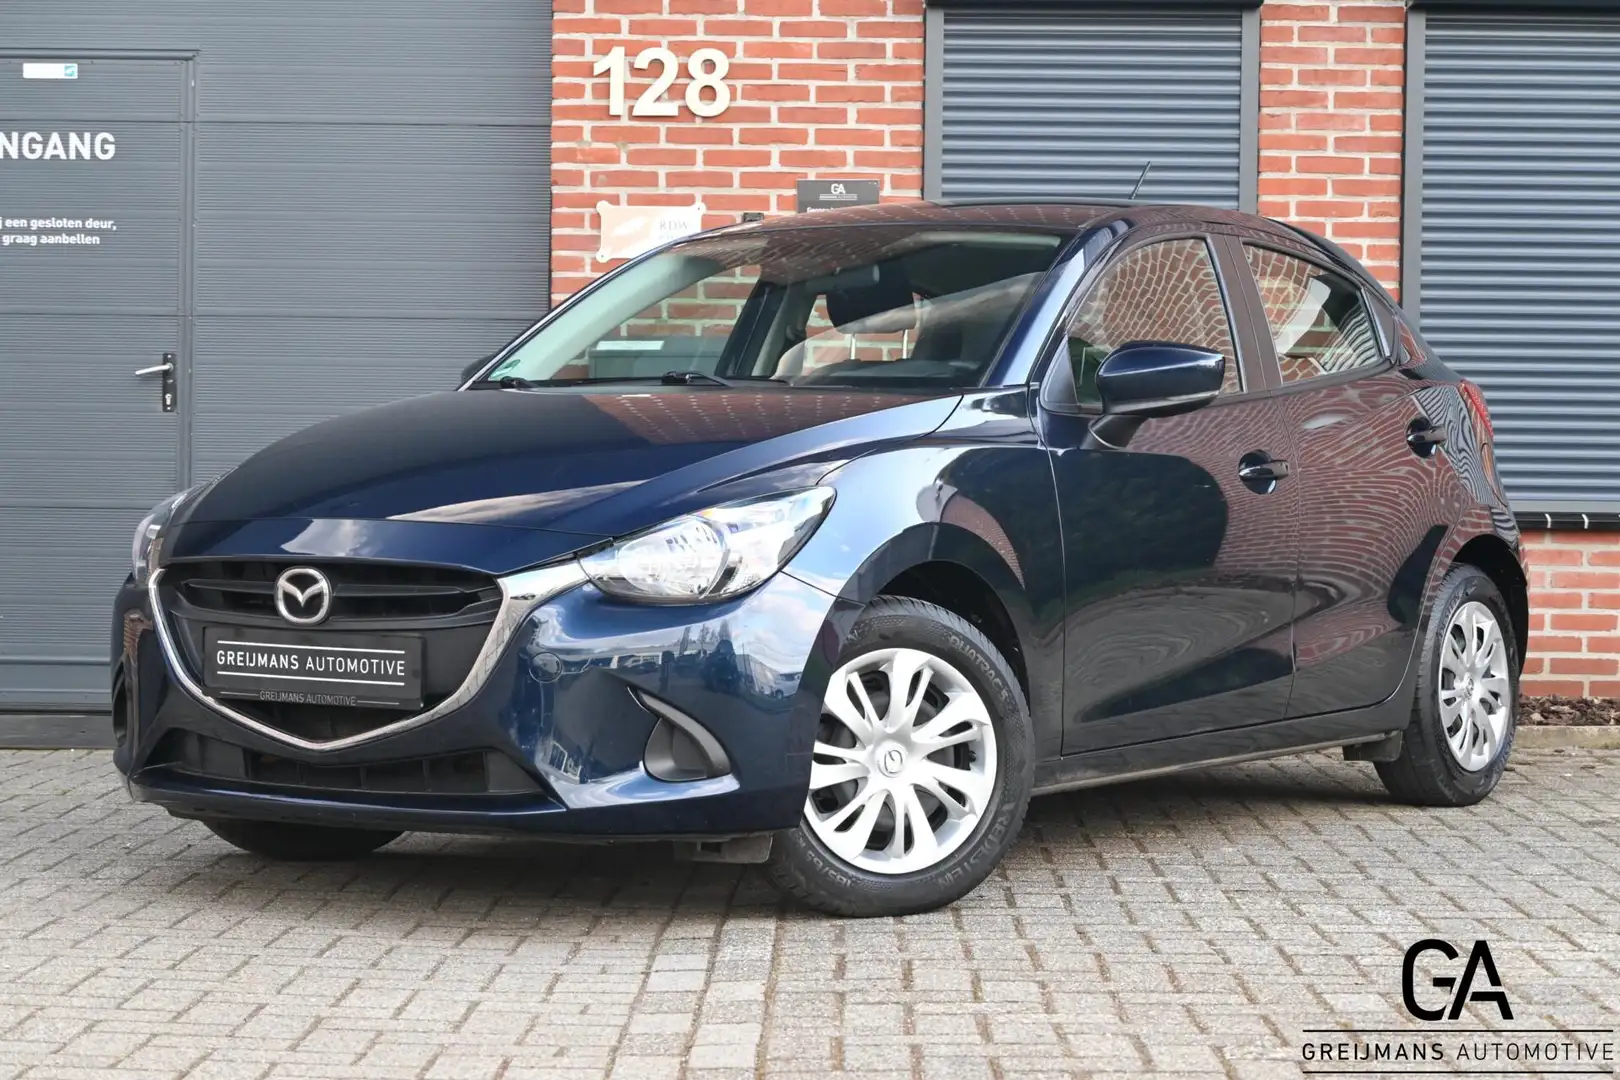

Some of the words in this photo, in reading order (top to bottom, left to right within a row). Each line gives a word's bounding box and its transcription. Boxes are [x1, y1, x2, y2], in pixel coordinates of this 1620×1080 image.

[593, 46, 731, 117] 128
[830, 183, 846, 194] GA
[5, 219, 28, 228] een
[30, 217, 82, 231] gesloten
[85, 218, 117, 231] deur,
[660, 218, 689, 231] RDW
[2, 235, 38, 246] graag
[40, 233, 101, 245] aanbellen
[217, 650, 299, 669] GREIJMANS
[306, 656, 405, 676] AUTOMOTIVE
[260, 691, 305, 703] GREIJMANS
[306, 694, 357, 706] AUTOMOTIVE
